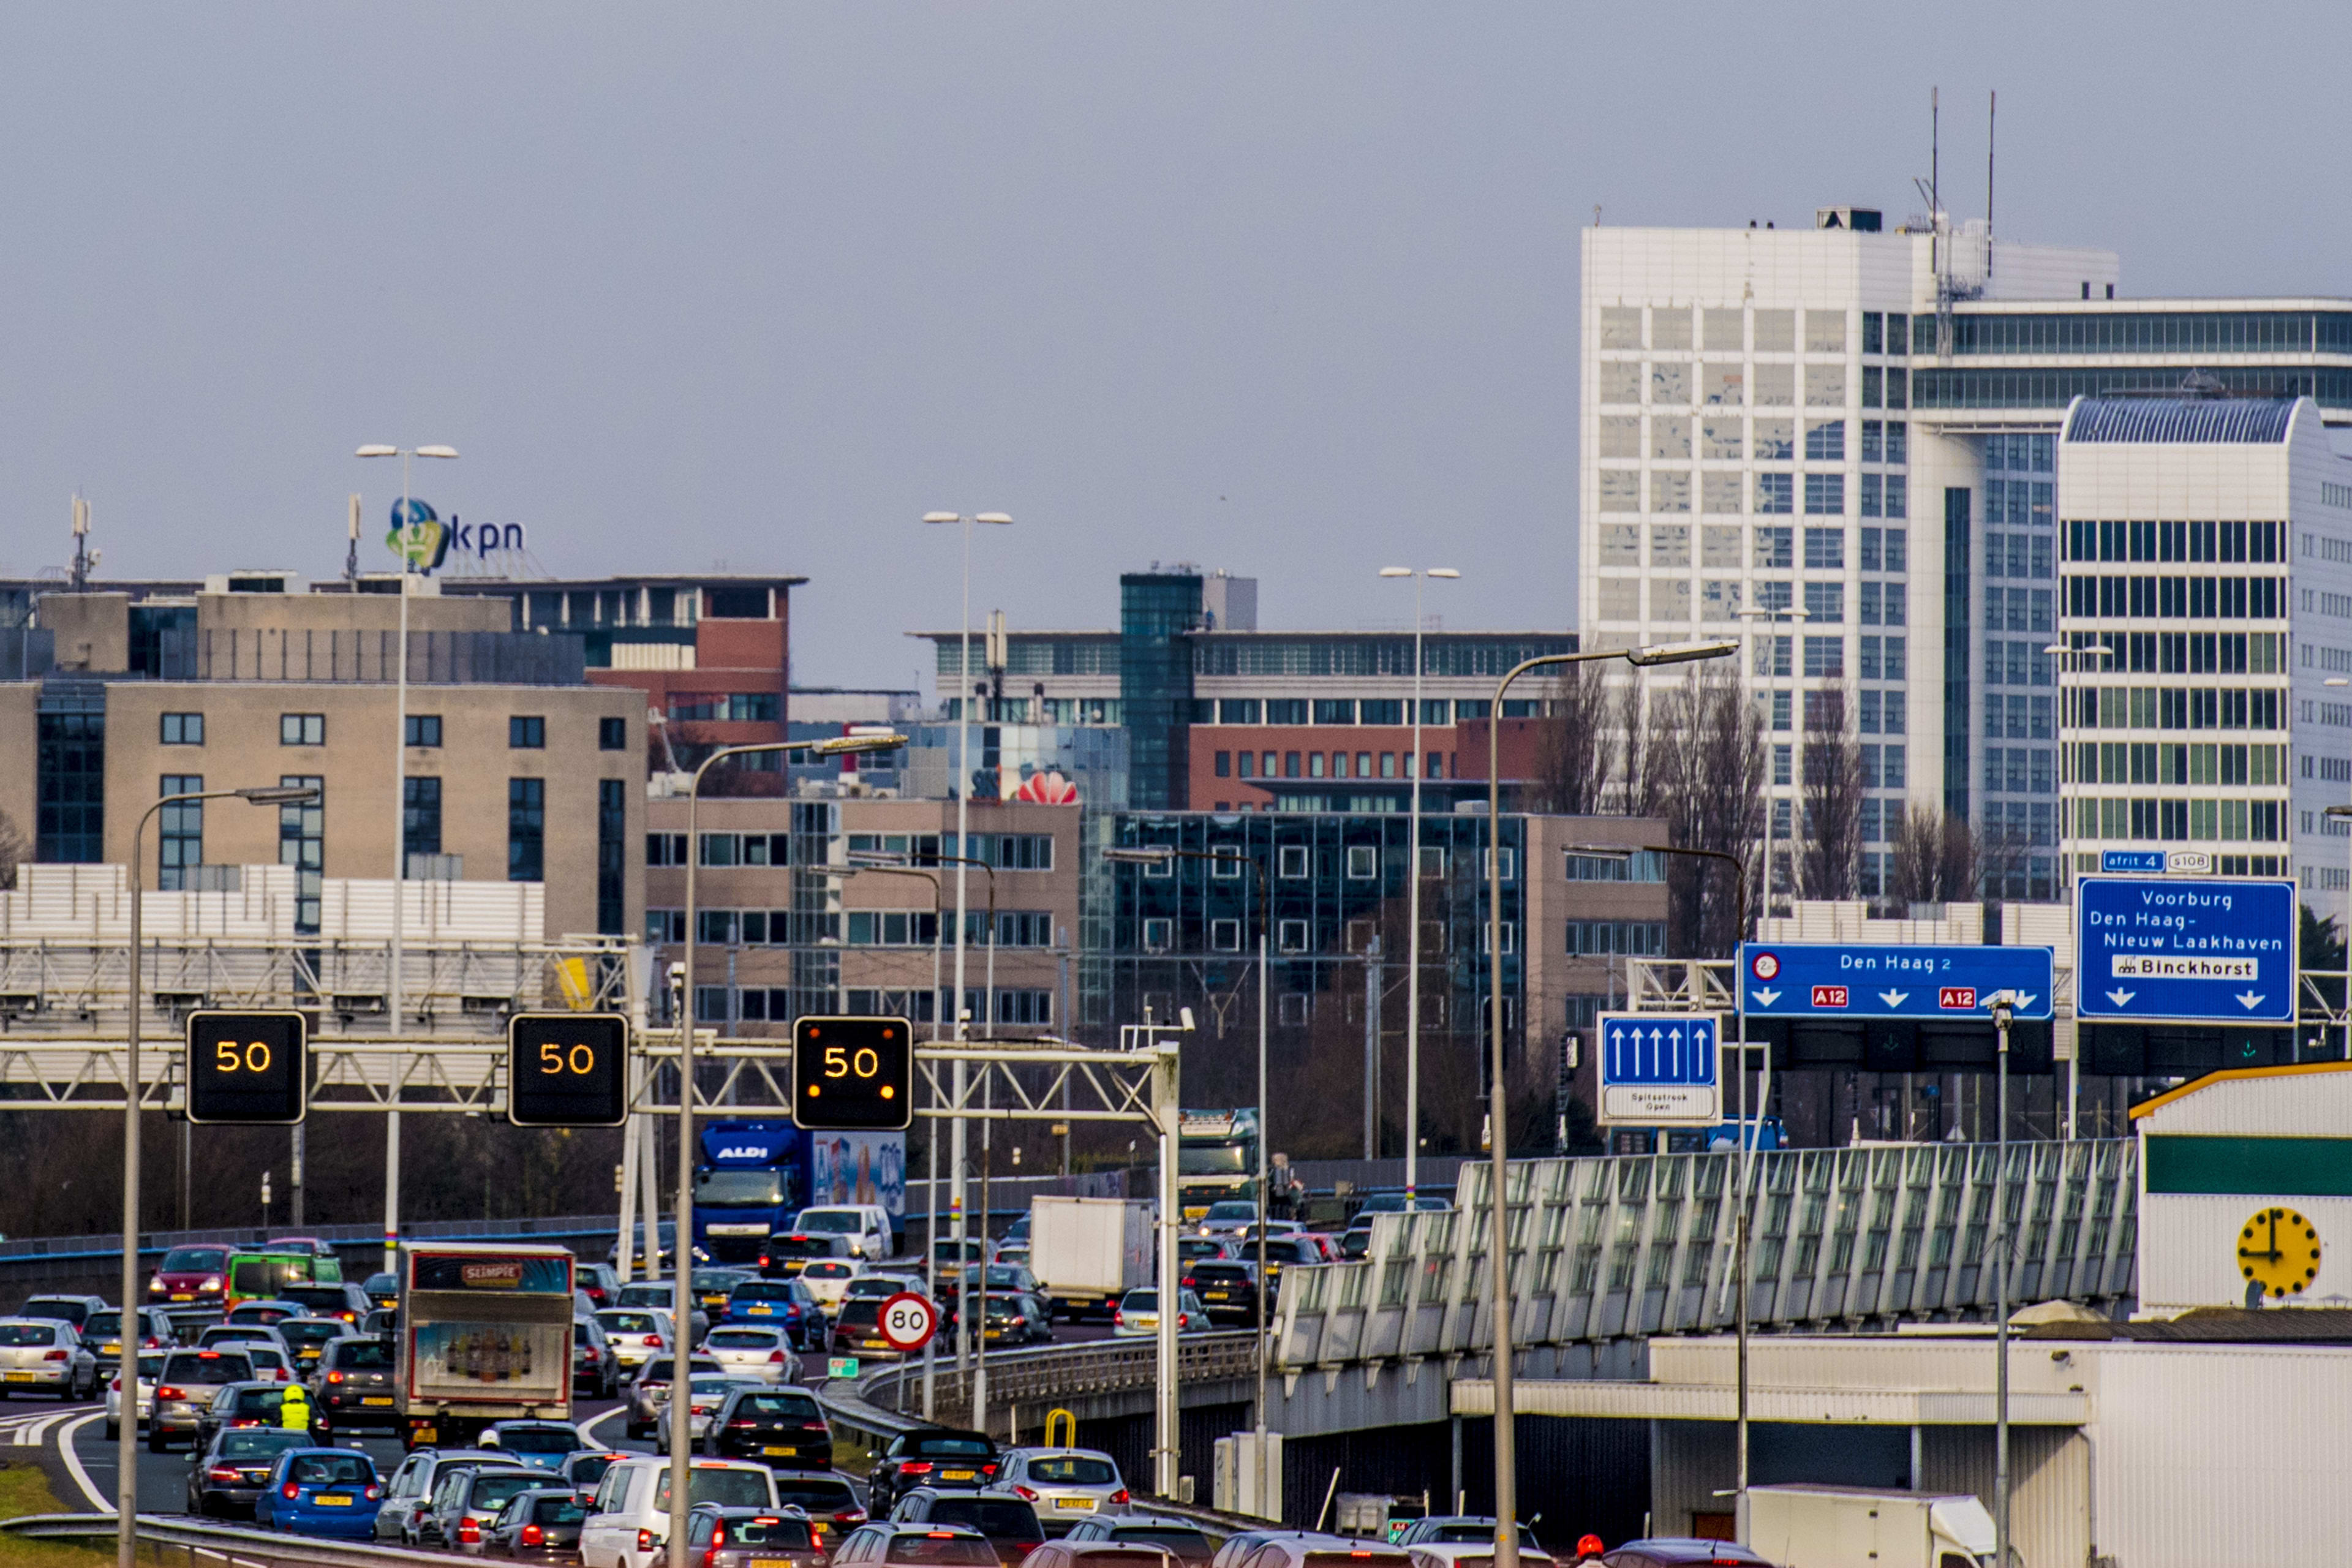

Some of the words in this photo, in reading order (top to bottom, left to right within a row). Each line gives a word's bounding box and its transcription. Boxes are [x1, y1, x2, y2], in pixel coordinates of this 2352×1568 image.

[451, 514, 524, 559] kpn
[2109, 856, 2138, 865] afrit
[2146, 856, 2155, 867] 4
[2142, 891, 2232, 911] Voorburg
[2090, 911, 2126, 925] Den
[2136, 913, 2196, 930] Haag-
[2105, 933, 2164, 948] Nieuw
[2174, 935, 2282, 950] Laakhaven
[1841, 955, 1875, 969] Den
[1886, 956, 1933, 973] Haag
[1942, 959, 1950, 970] 2
[2142, 960, 2252, 975] Binckhorst
[1815, 990, 1845, 1004] A12
[1943, 992, 1972, 1005] A12
[216, 1041, 271, 1072] 50
[540, 1043, 594, 1074] 50
[824, 1047, 878, 1078] 50
[717, 1147, 769, 1159] ALDI
[892, 1310, 924, 1330] 80
